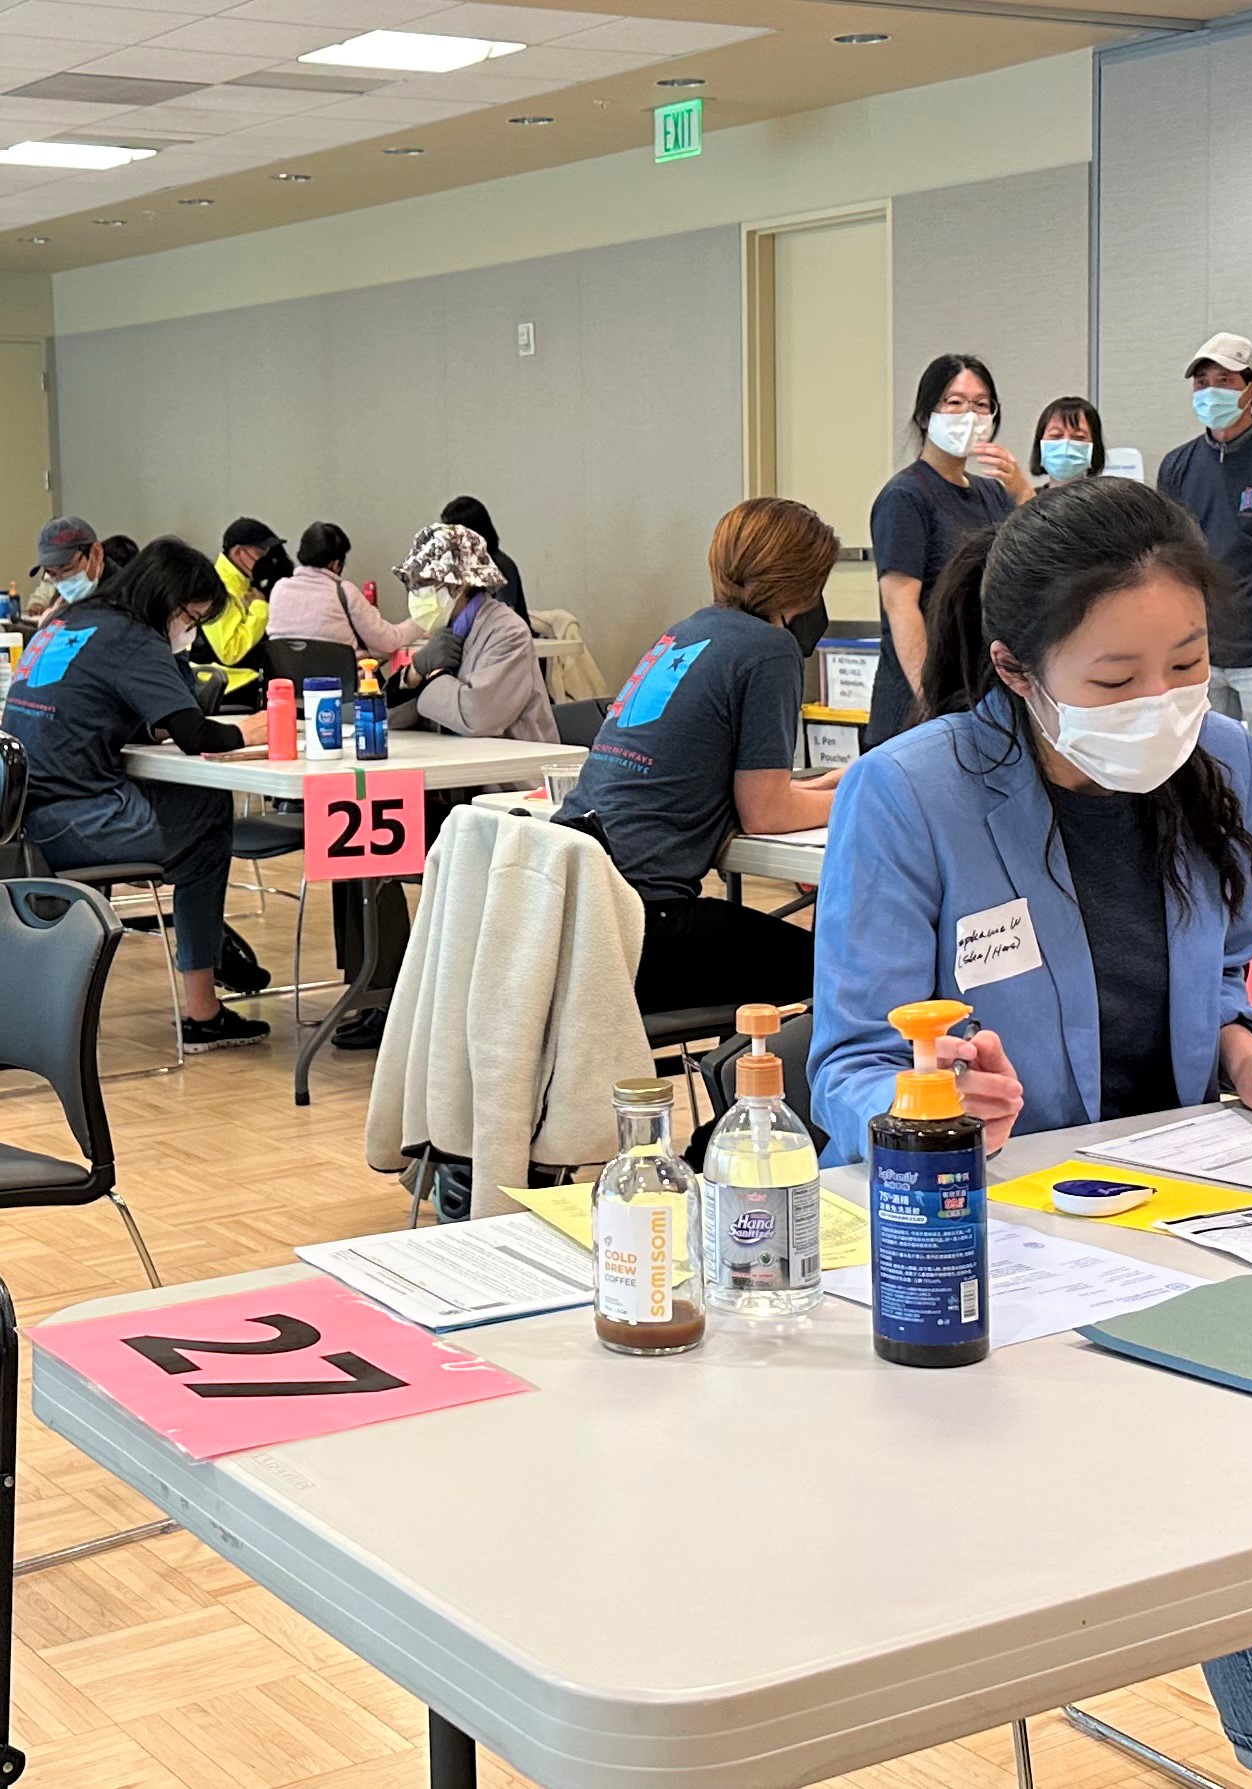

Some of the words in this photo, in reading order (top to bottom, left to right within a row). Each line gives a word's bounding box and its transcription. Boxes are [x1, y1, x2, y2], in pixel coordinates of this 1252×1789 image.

[663, 108, 693, 152] EXIT
[822, 736, 836, 746] Pen
[327, 798, 406, 858] 25
[737, 1214, 775, 1230] Hand
[729, 1223, 776, 1239] Sanitizer
[604, 1249, 638, 1264] COLD
[604, 1262, 637, 1275] BREW
[604, 1273, 637, 1288] COFFEE
[120, 1313, 411, 1399] 27
